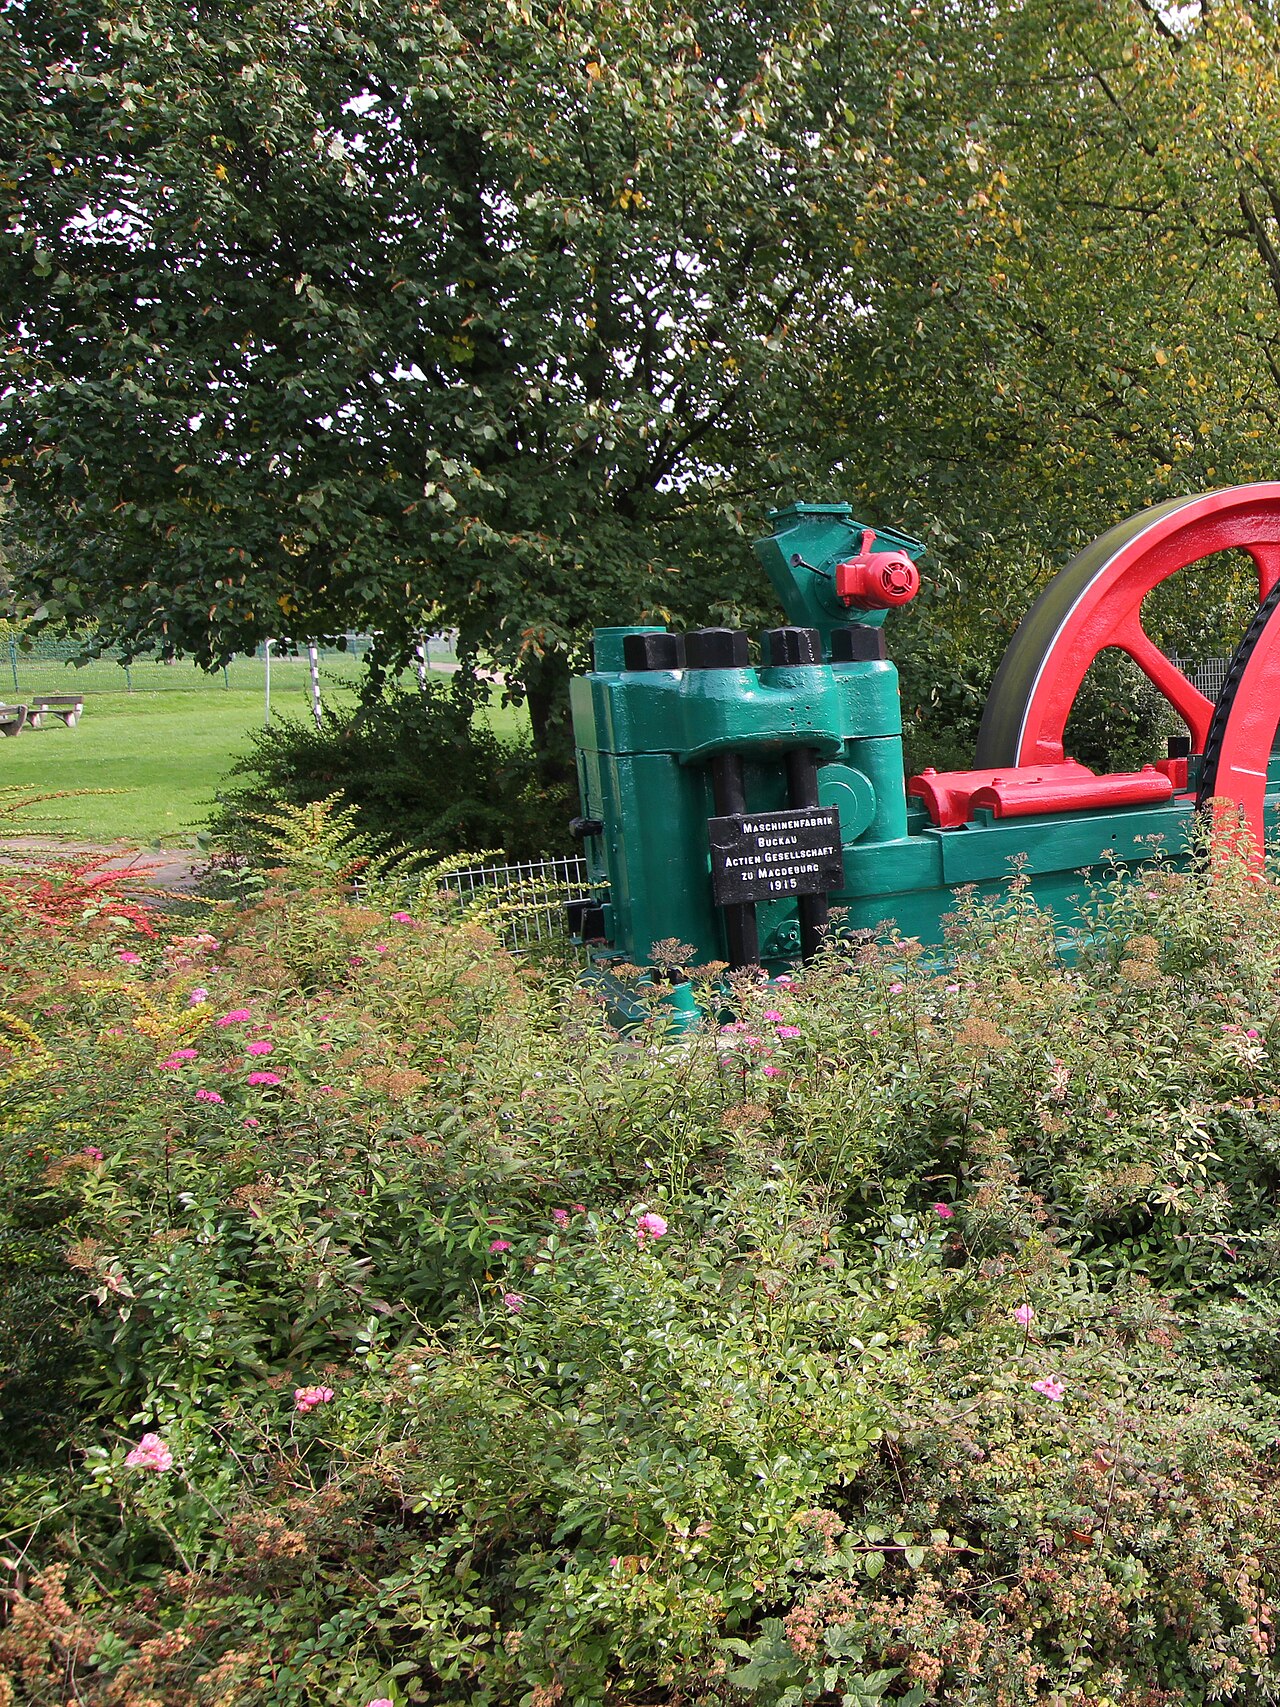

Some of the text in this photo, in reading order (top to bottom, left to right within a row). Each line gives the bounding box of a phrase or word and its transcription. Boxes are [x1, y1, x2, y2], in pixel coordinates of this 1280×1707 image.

[743, 817, 833, 833] MASCHINENFABRIK
[758, 836, 797, 847] BUCKAU
[725, 846, 834, 867] ACTIEN GESELLSCHAFT
[758, 863, 819, 879] MAGDEBURG
[769, 878, 798, 891] 1915
